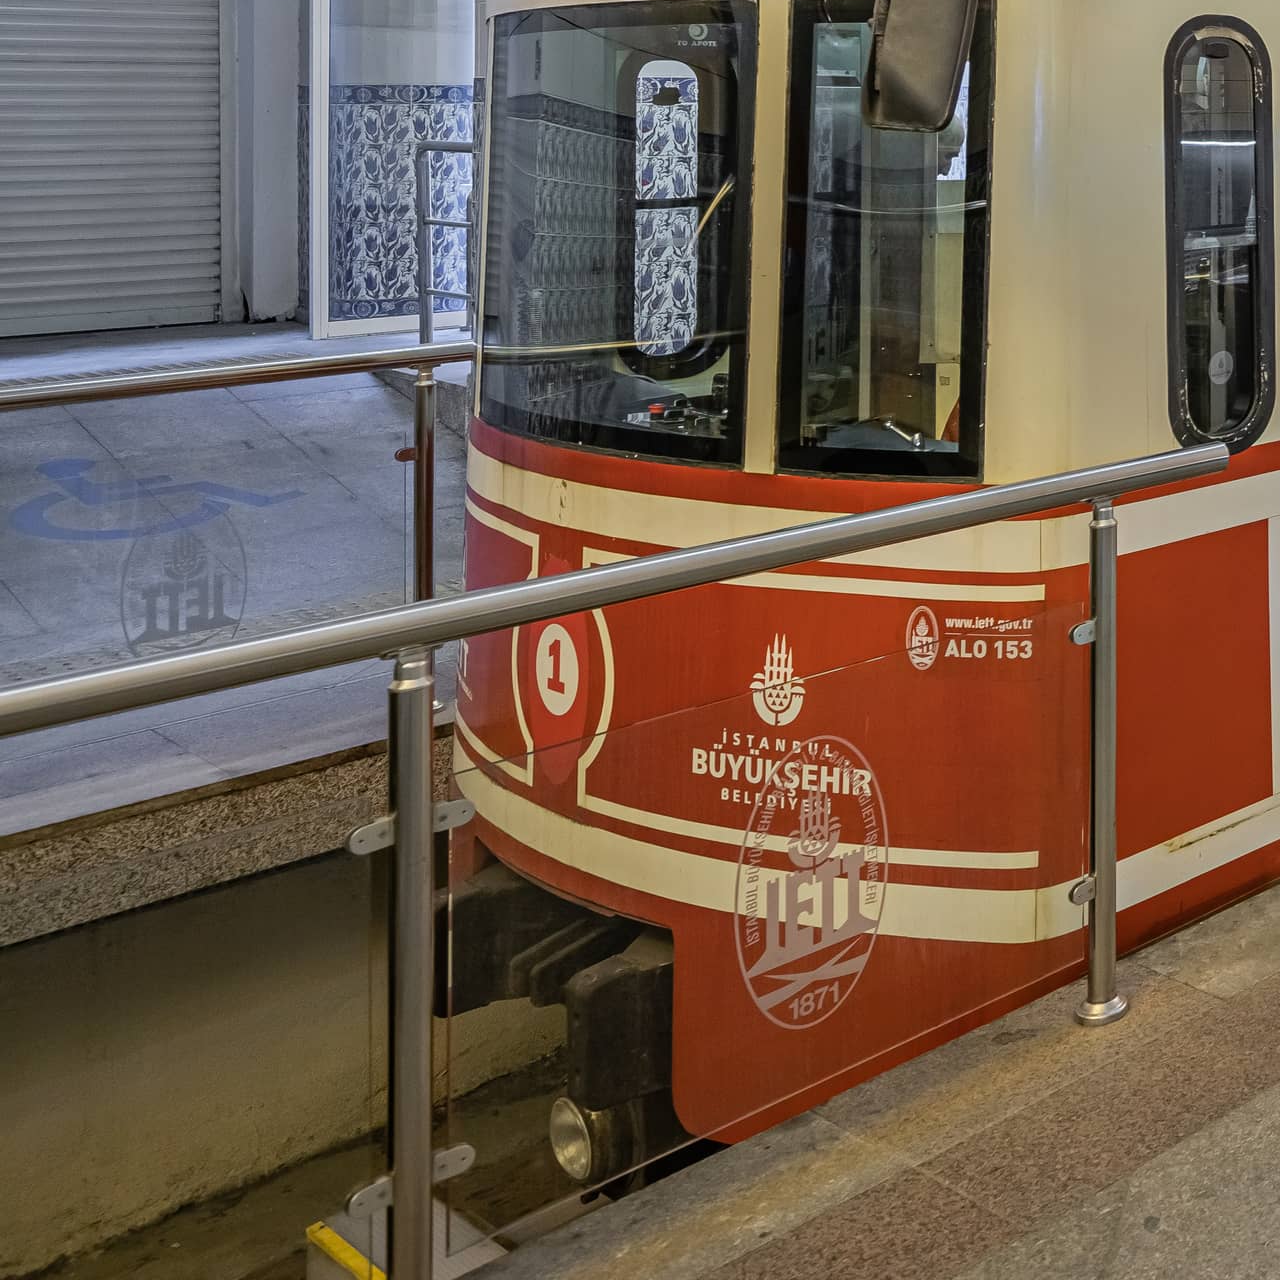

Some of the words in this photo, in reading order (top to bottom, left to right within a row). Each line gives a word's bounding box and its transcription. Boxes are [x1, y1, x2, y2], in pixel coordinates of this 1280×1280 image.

[944, 639, 988, 659] ALO
[994, 640, 1033, 659] 153
[546, 638, 566, 696] 1
[721, 727, 833, 758] İSTANBUL
[692, 742, 873, 798] BÜYÜKŞEHİR
[720, 787, 833, 816] BELEDİYESİ
[788, 981, 840, 1021] 1871
